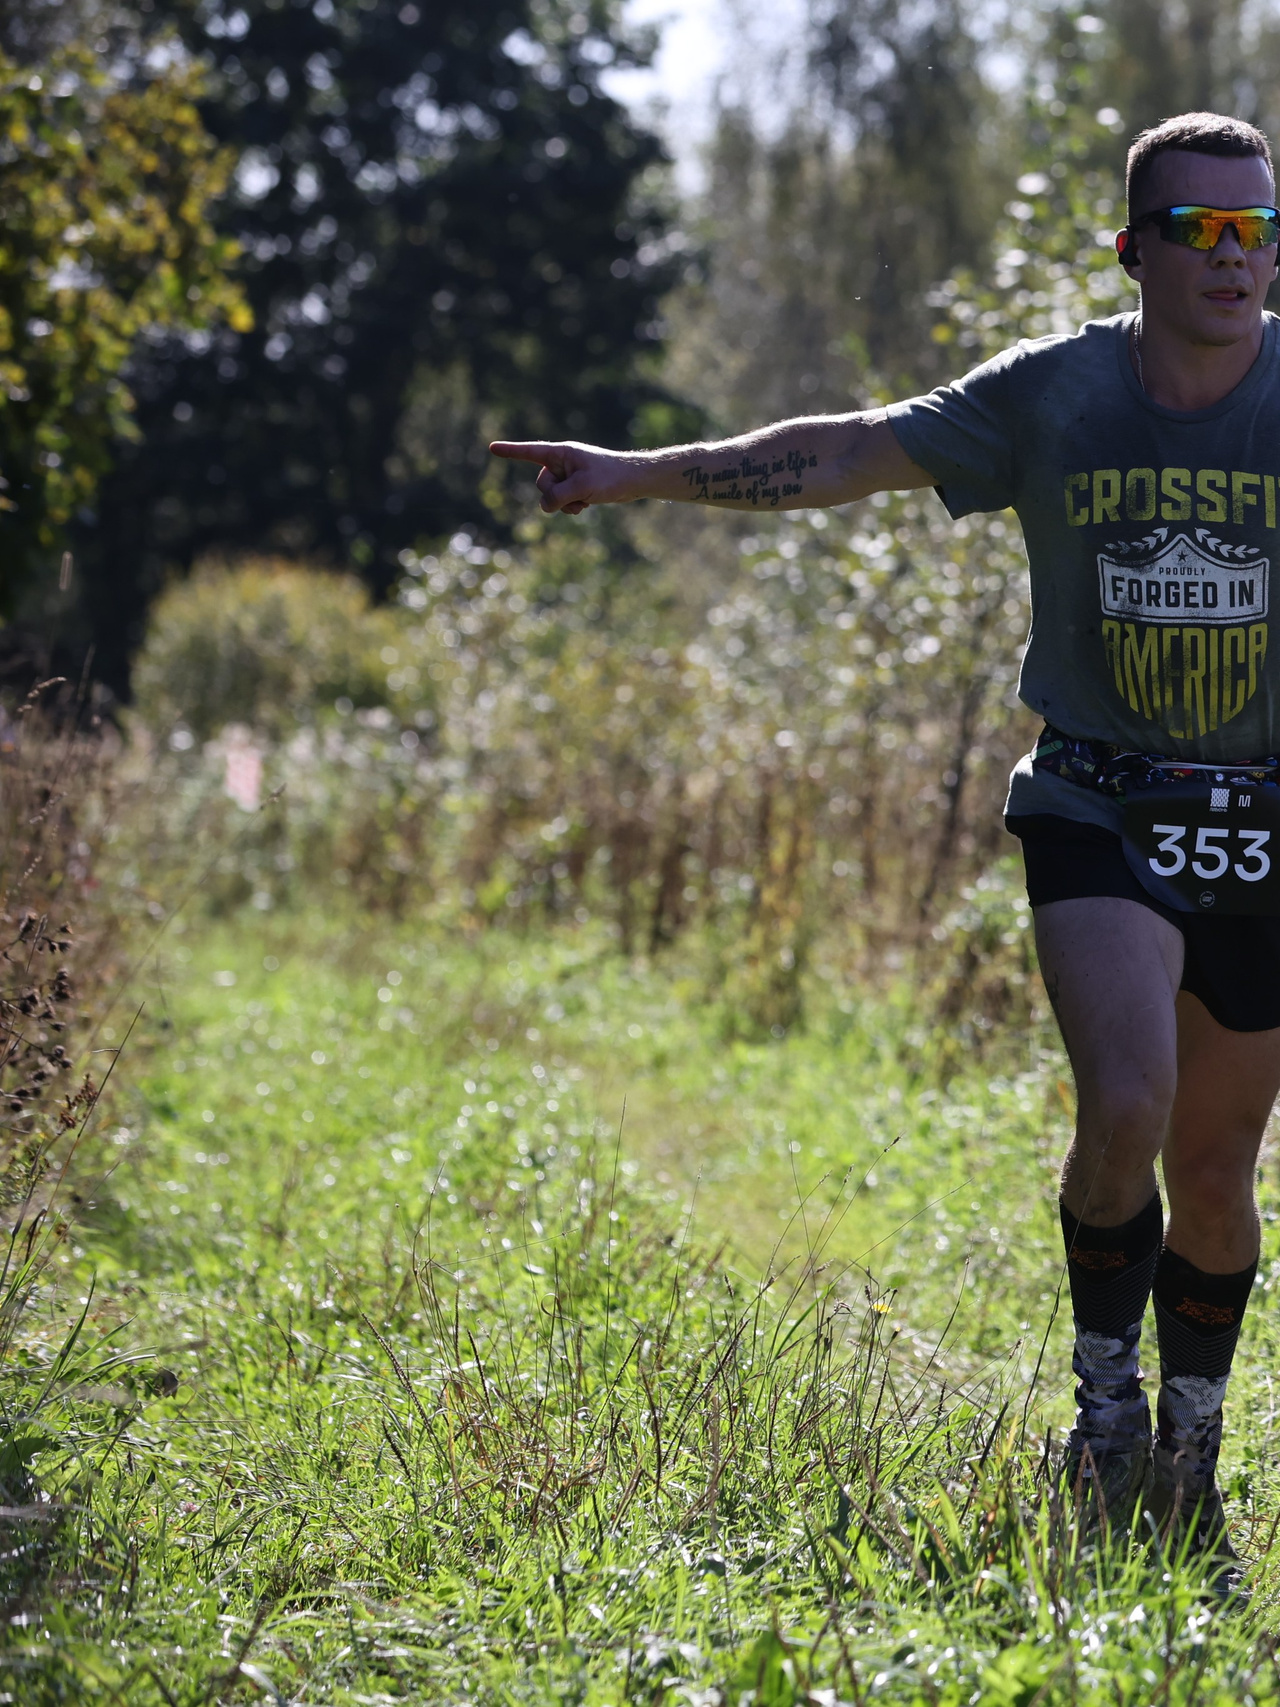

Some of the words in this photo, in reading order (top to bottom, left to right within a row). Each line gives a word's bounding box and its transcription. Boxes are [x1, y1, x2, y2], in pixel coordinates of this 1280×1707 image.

[683, 466, 709, 486] The
[712, 462, 740, 483] main
[740, 457, 772, 486] thing
[772, 455, 785, 474] in
[787, 451, 807, 479] life
[808, 451, 818, 468] is
[690, 485, 709, 500] A
[712, 482, 743, 500] smile
[745, 481, 760, 505] of
[762, 486, 780, 506] my
[782, 483, 803, 497] son
[1158, 566, 1206, 577] PROUDLY
[1111, 575, 1219, 609] FORGED
[1229, 579, 1255, 608] IN
[1102, 619, 1268, 740] AMERICA
[1238, 794, 1251, 808] M
[1148, 824, 1271, 882] 353
